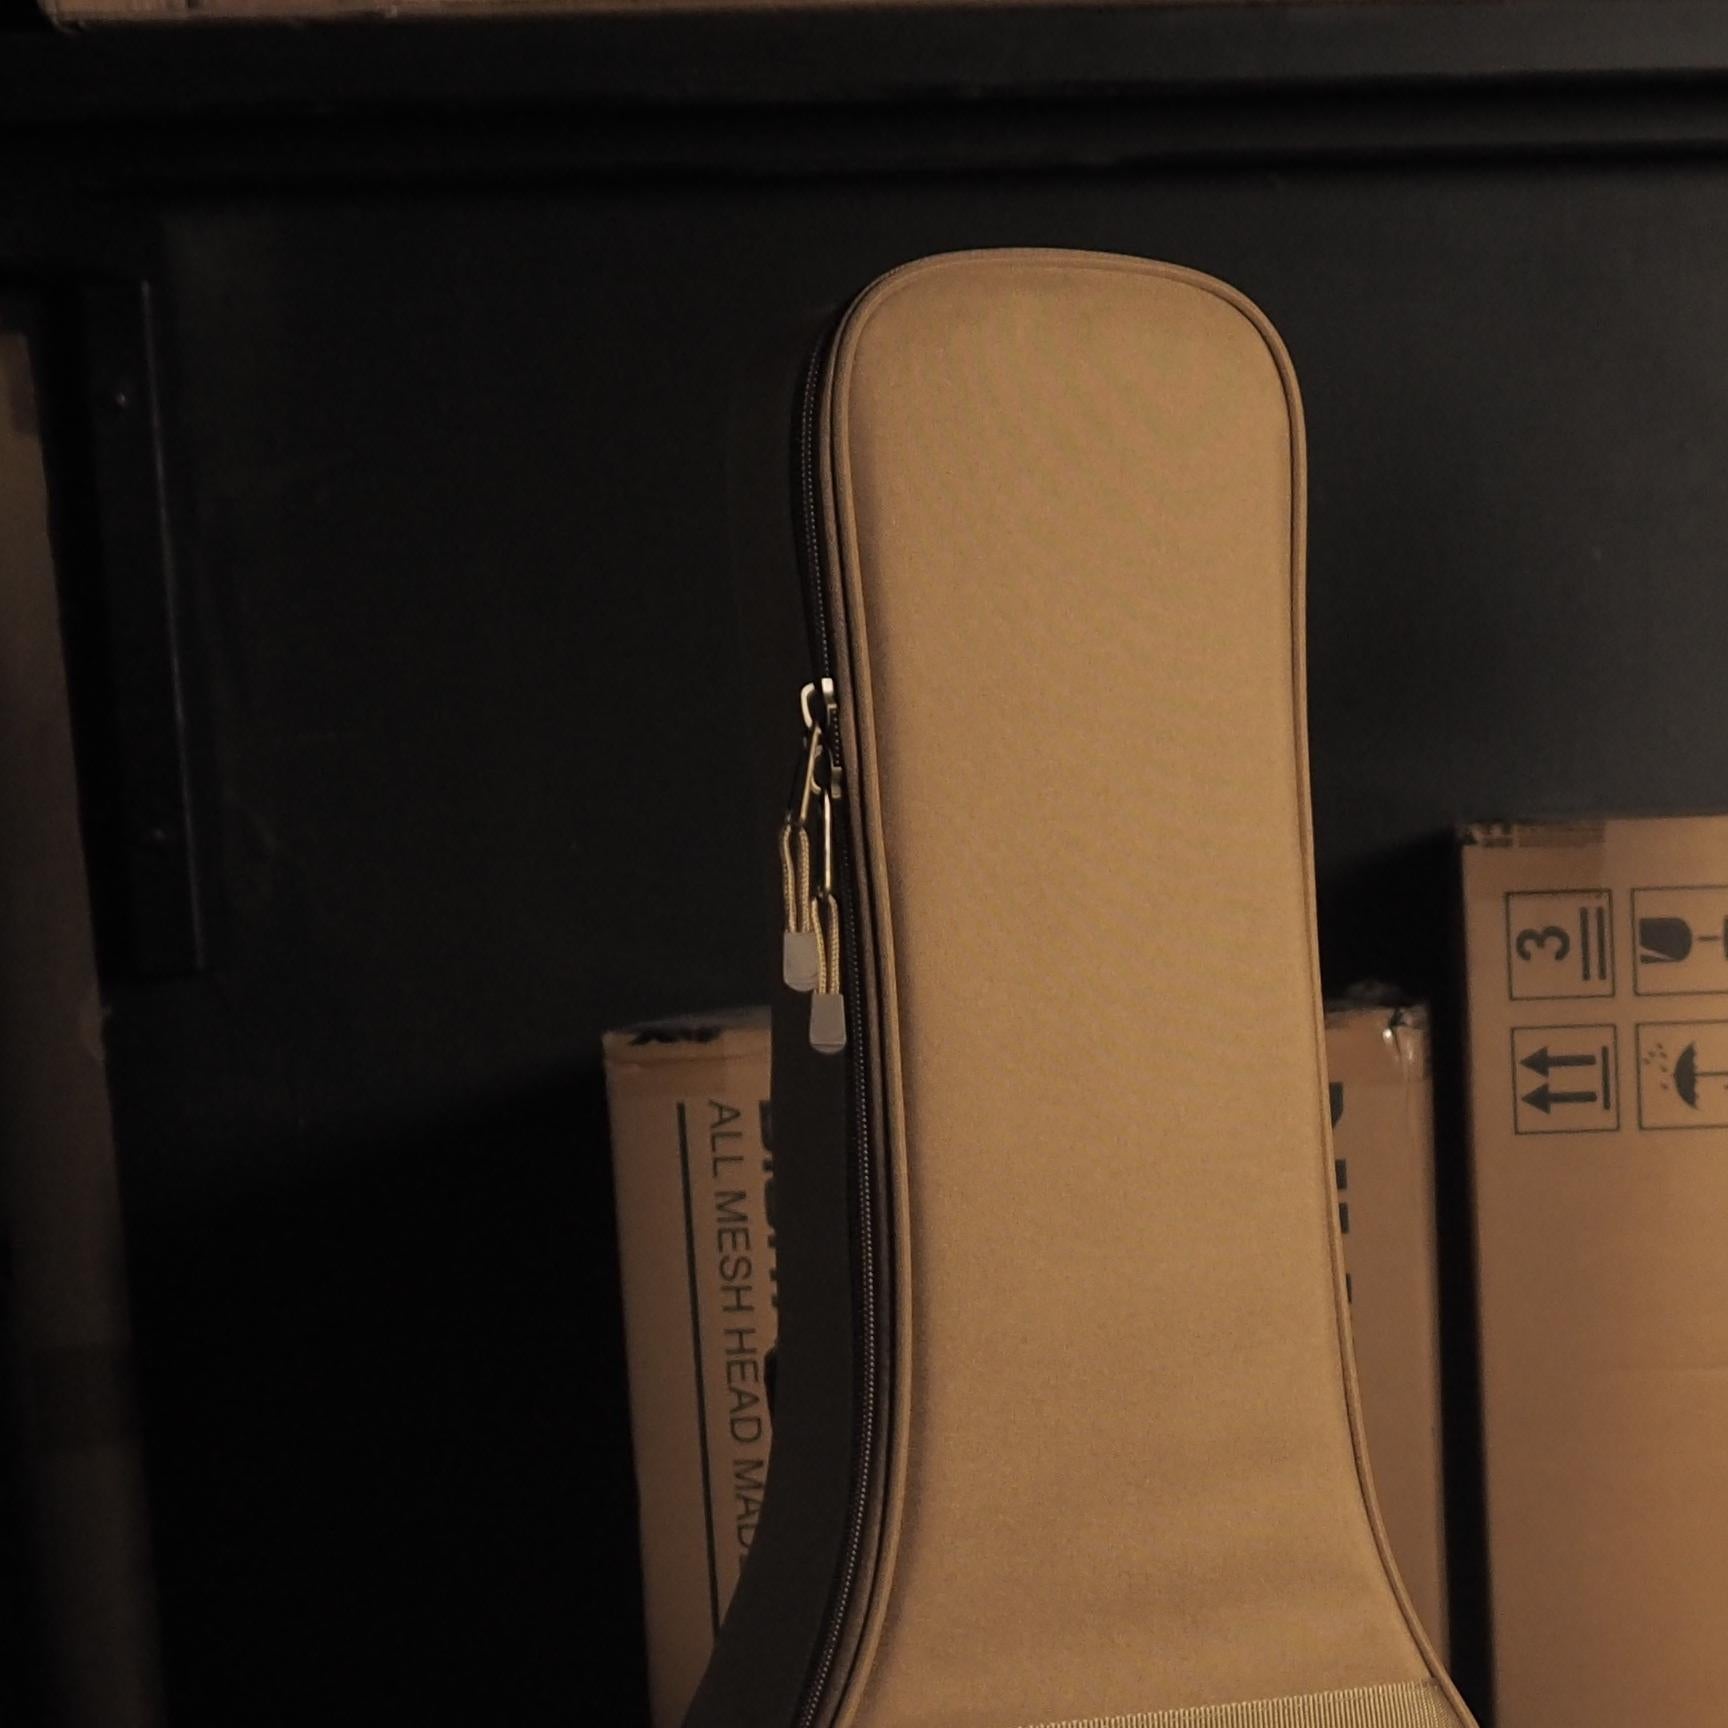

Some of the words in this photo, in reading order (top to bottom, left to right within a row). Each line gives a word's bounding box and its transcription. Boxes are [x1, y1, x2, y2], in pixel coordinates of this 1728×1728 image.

[1516, 925, 1570, 961] 3
[708, 1099, 744, 1177] ALL
[714, 1190, 754, 1313] MESH
[723, 1328, 763, 1443] HEAD
[733, 1458, 764, 1568] MAD
